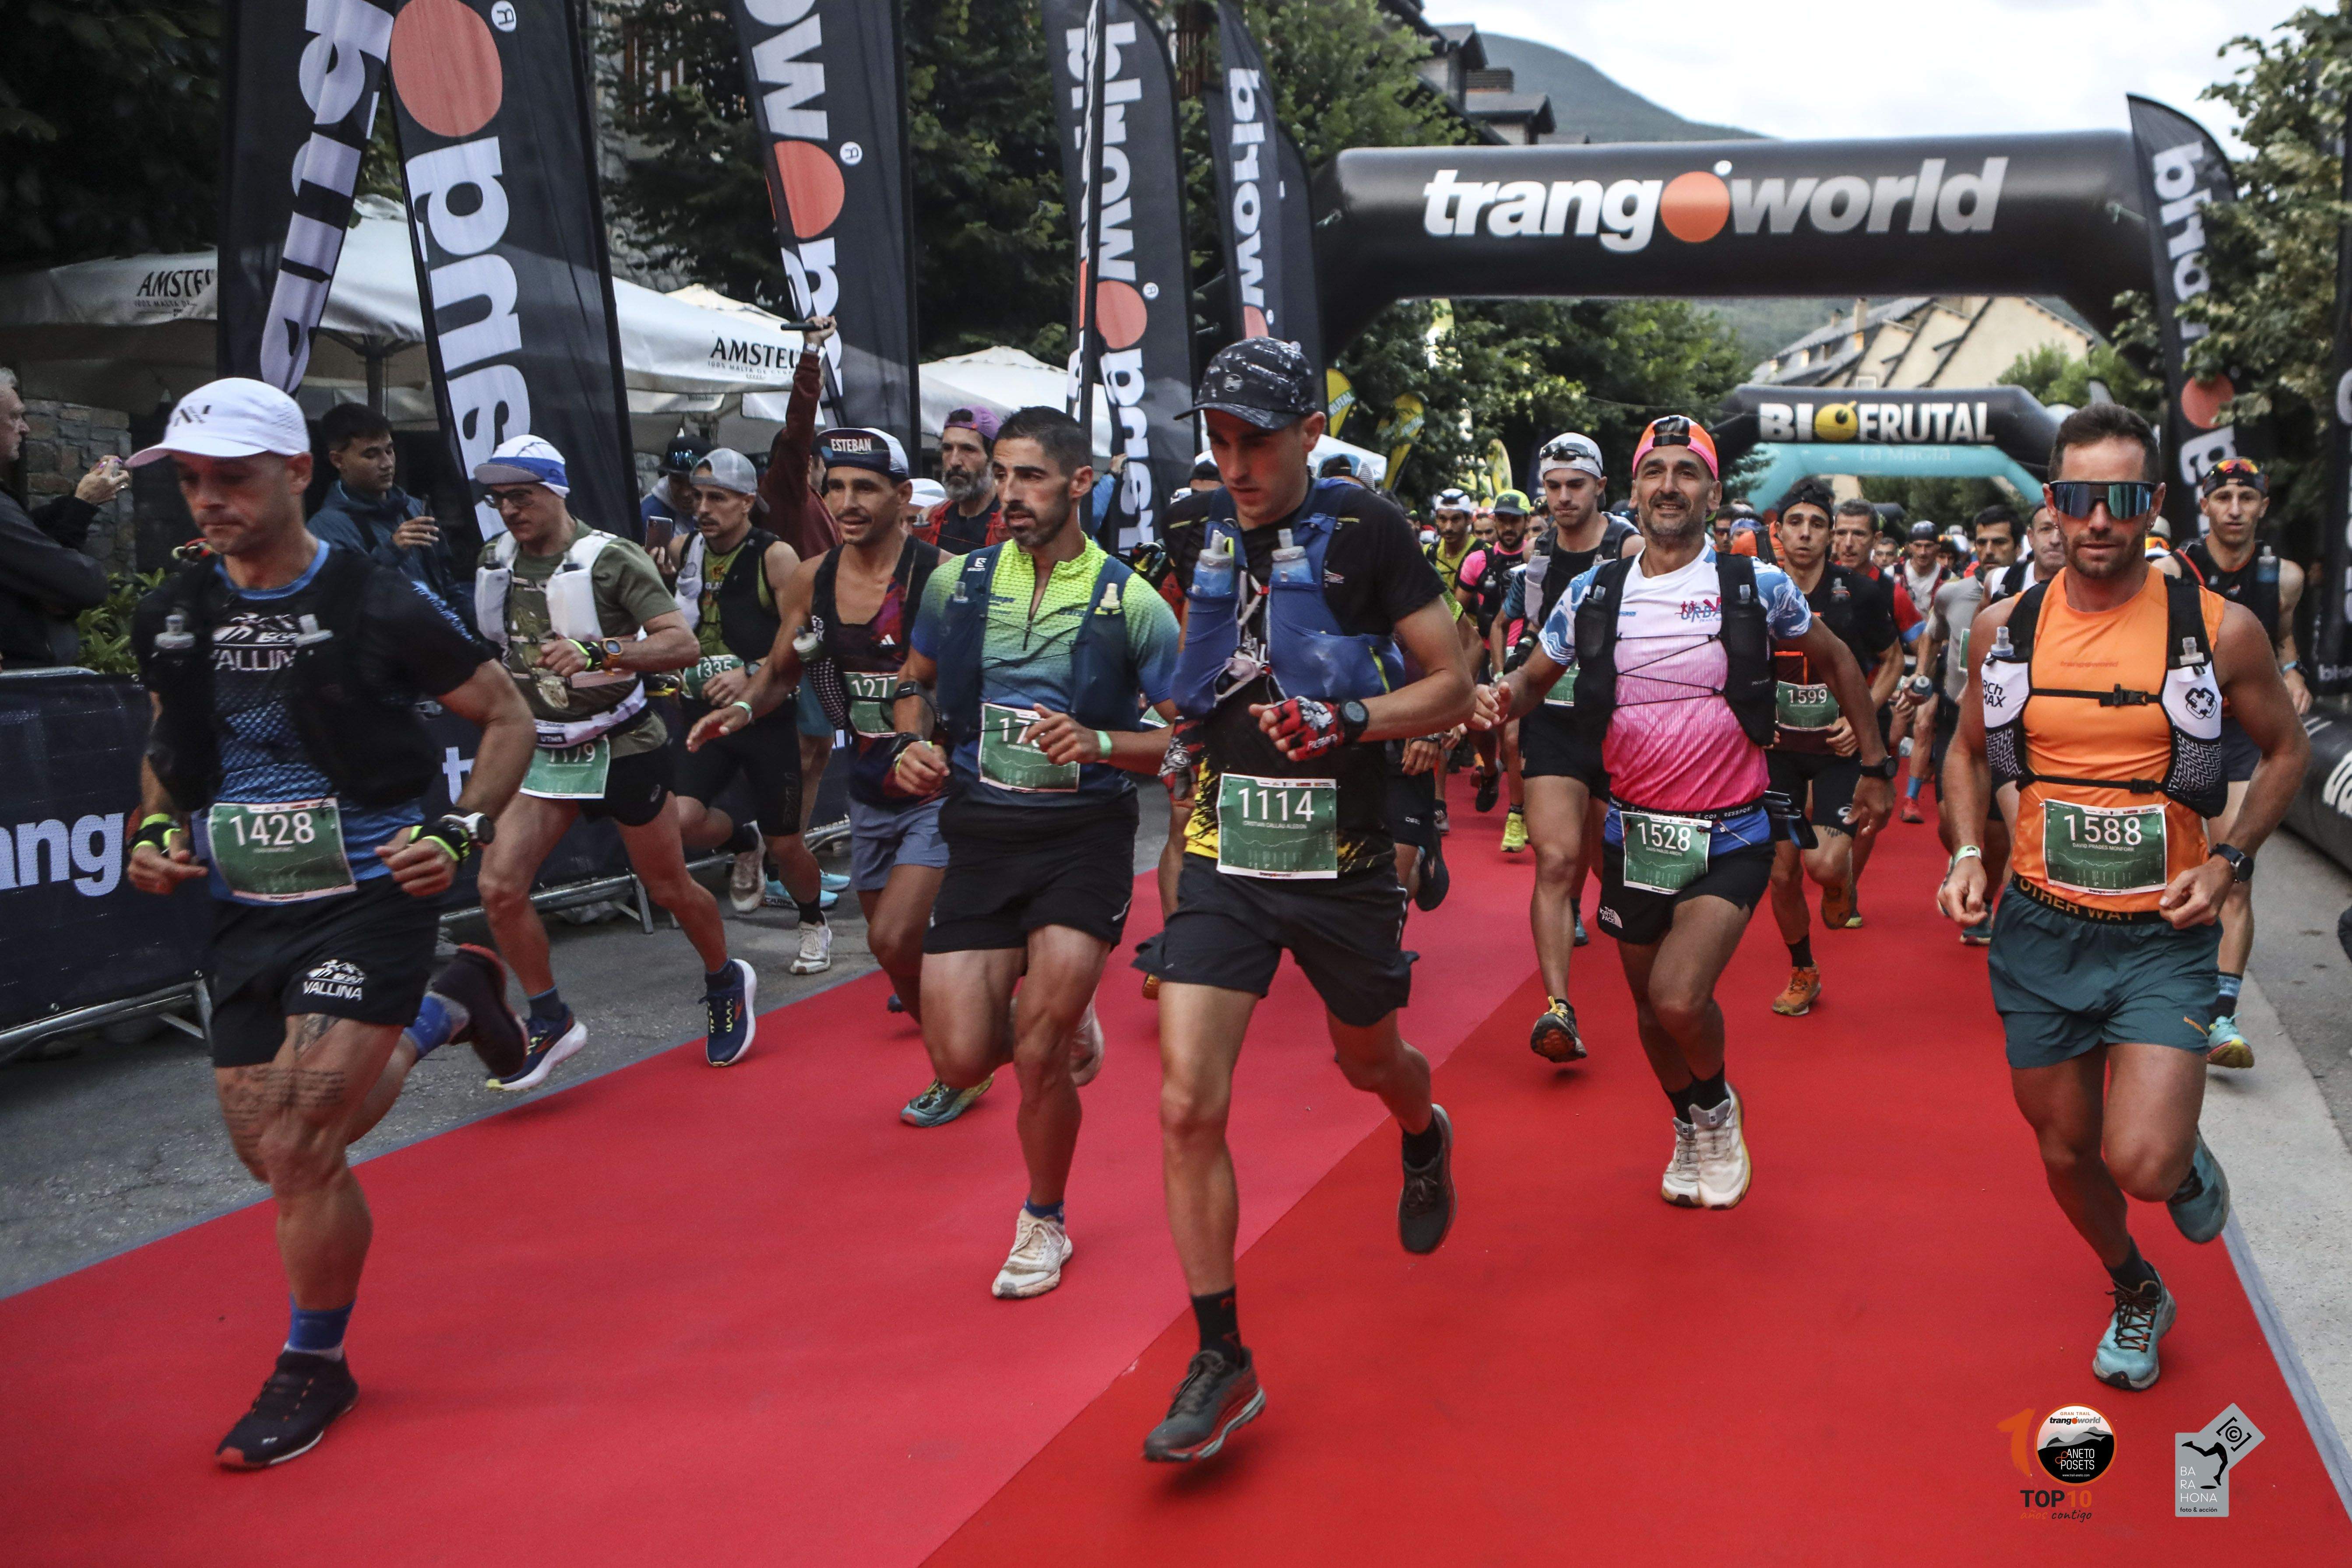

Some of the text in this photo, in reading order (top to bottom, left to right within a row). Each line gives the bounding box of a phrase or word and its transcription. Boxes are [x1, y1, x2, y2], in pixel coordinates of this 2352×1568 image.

[729, 364, 753, 373] MALTA
[831, 437, 872, 452] ESTEBAN
[210, 649, 315, 671] ALLIN
[1788, 688, 1827, 704] 1599
[1238, 787, 1315, 822] 1114
[229, 811, 315, 846] 1428
[1637, 822, 1691, 852] 1528
[2064, 814, 2142, 846] 1588
[303, 980, 363, 1002] VALLINA
